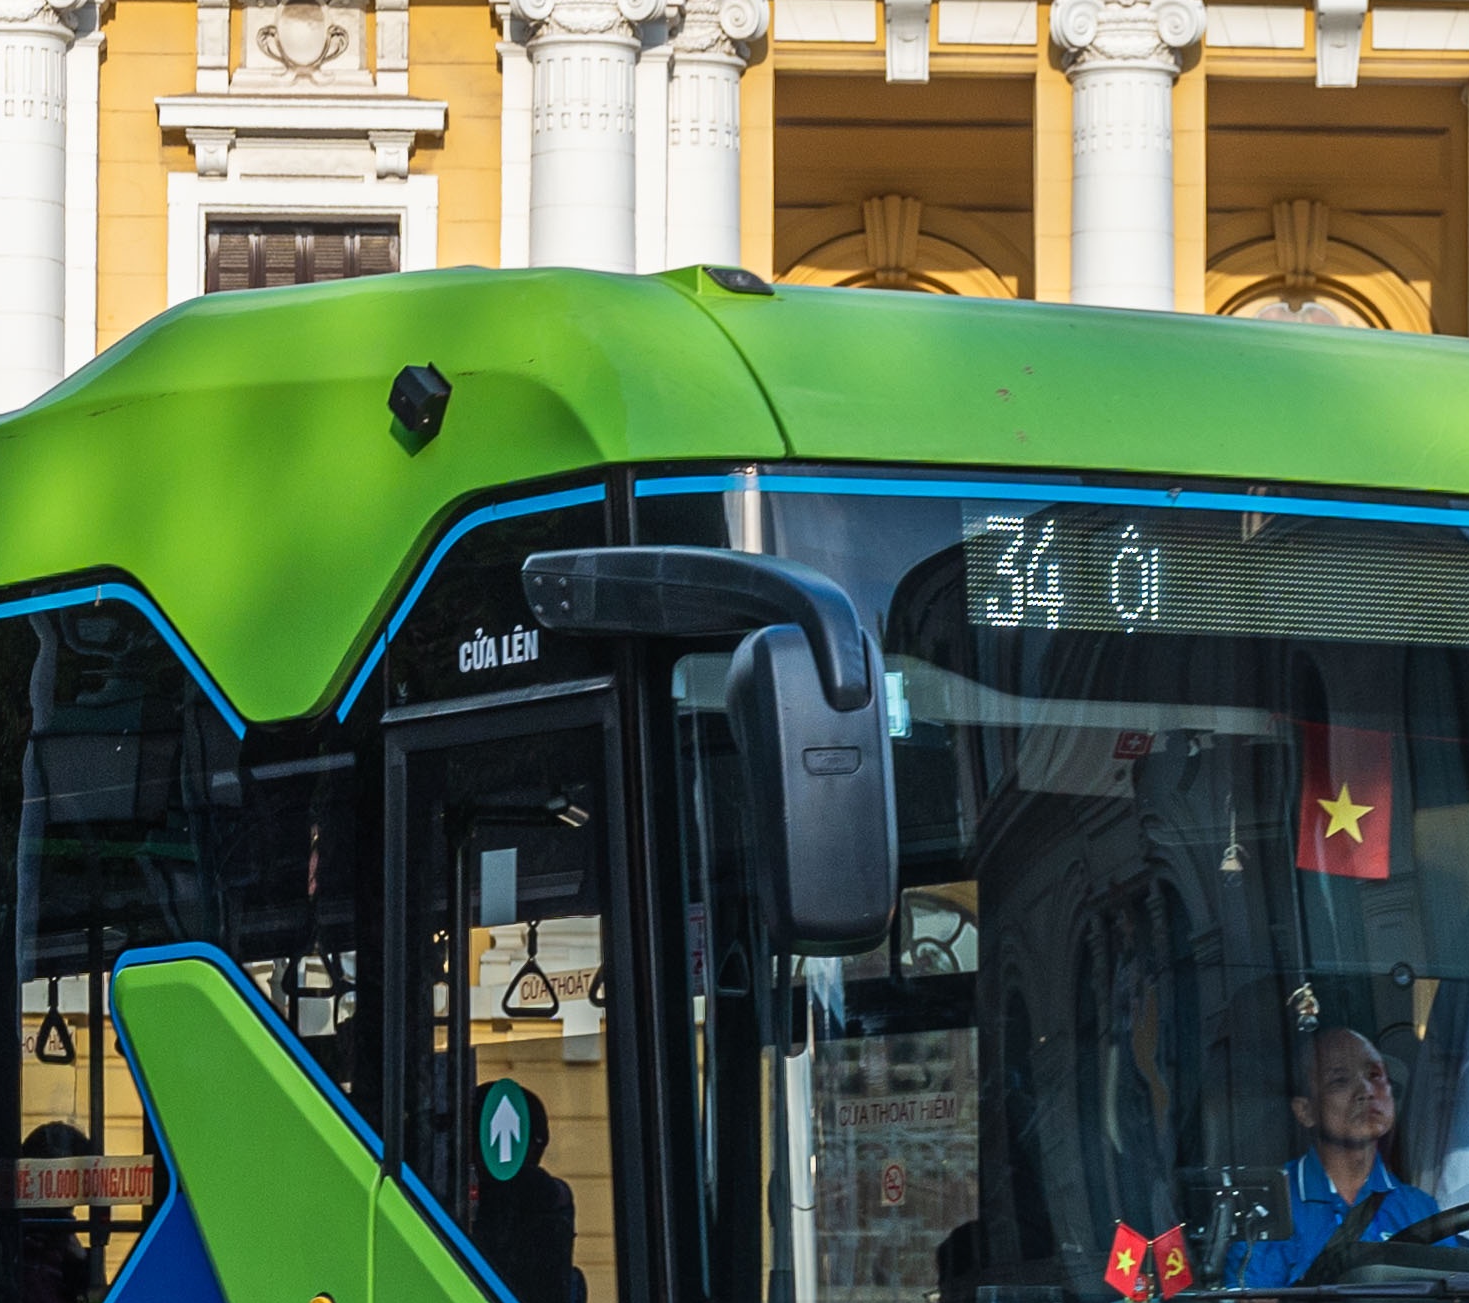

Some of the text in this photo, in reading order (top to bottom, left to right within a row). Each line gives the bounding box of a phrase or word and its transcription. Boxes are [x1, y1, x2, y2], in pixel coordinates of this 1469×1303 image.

[986, 514, 1065, 631] 34
[459, 623, 540, 674] CỬA LÊN
[38, 1168, 79, 1199] 10.000
